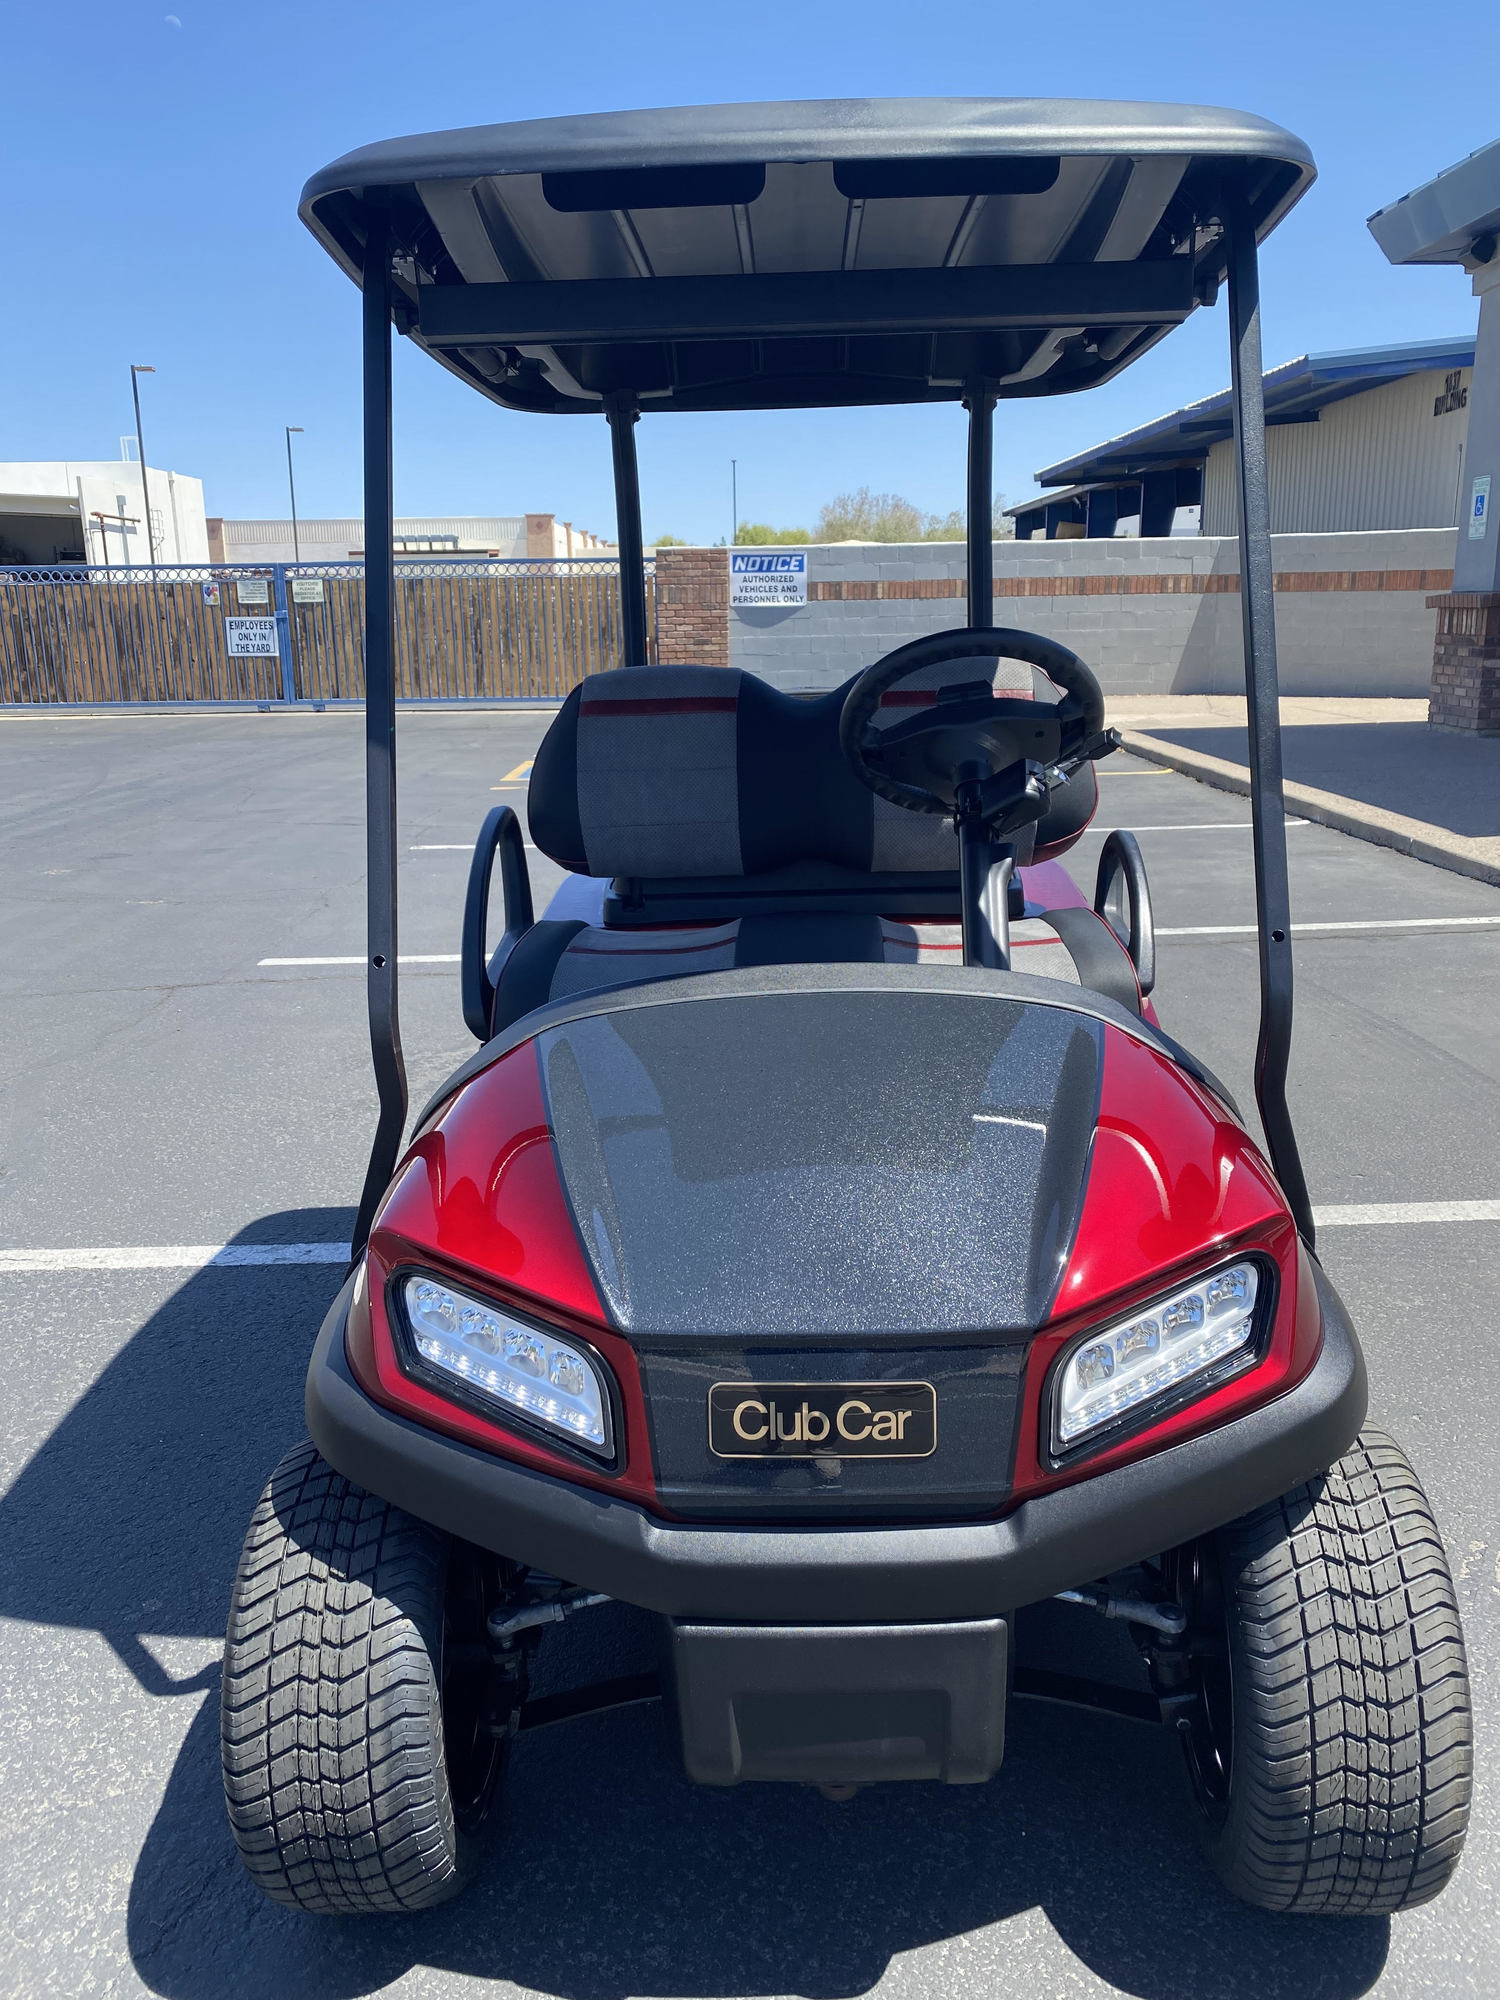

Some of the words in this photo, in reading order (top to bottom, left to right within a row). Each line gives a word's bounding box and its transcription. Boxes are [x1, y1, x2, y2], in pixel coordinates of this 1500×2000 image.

[1434, 387, 1467, 416] BUILDING
[734, 556, 802, 571] NOTICE
[742, 575, 794, 583] AUTHORIZED
[739, 585, 780, 593] VEHICLES
[733, 595, 780, 603] PERSONNEL
[783, 595, 804, 603] ONLY
[229, 620, 273, 630] EMPLOYEES
[238, 632, 258, 641] ONLY
[258, 632, 267, 641] IN
[235, 643, 250, 653] THE
[250, 643, 271, 653] YARD
[733, 1400, 831, 1441] Club
[836, 1400, 912, 1441] Car
